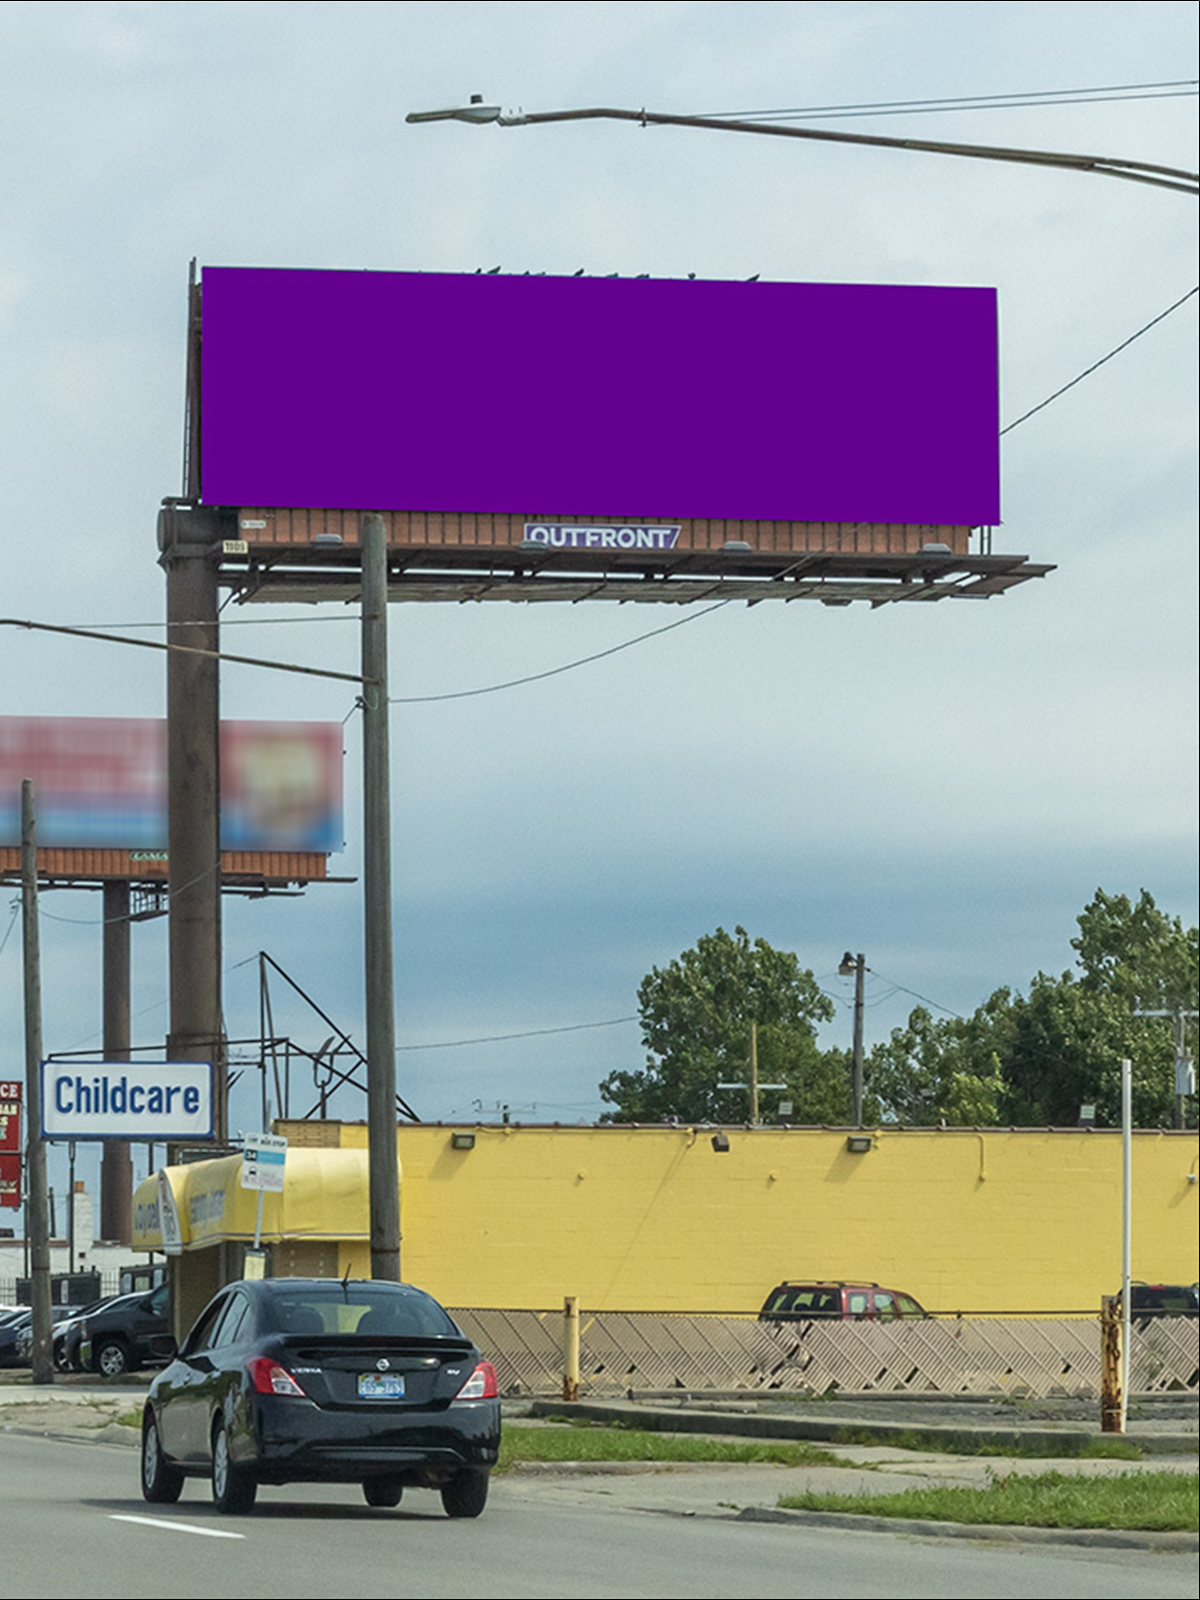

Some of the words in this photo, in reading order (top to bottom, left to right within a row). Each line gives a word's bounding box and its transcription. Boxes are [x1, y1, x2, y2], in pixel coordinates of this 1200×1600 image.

[530, 526, 671, 548] OUTFRONT
[133, 852, 169, 860] LAMA
[55, 1075, 200, 1114] Childcare
